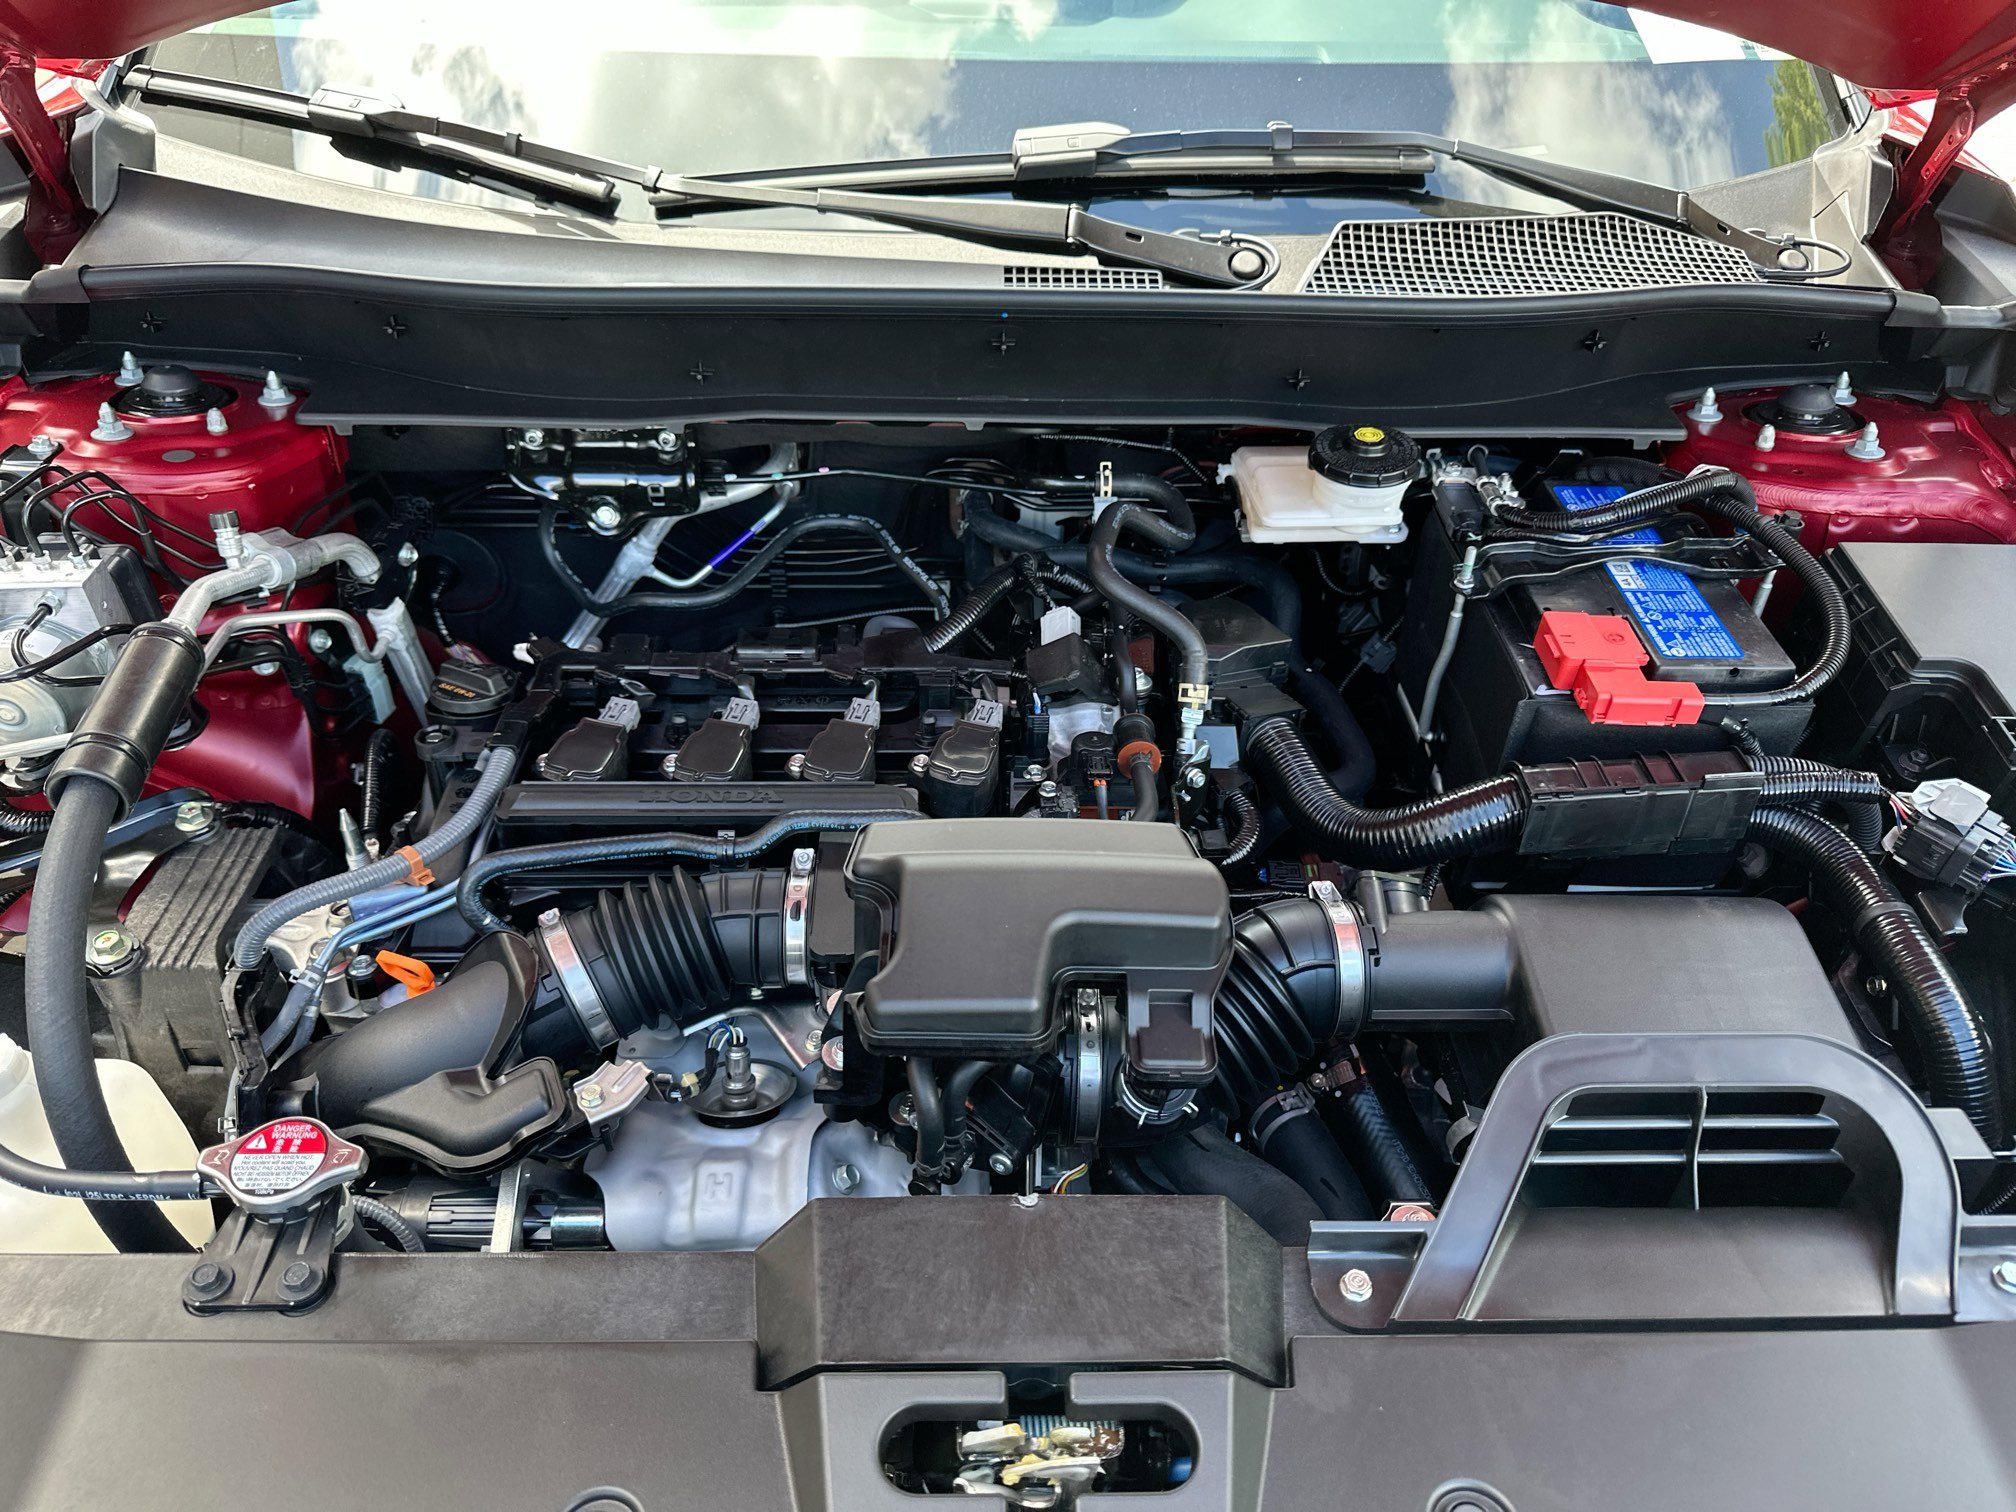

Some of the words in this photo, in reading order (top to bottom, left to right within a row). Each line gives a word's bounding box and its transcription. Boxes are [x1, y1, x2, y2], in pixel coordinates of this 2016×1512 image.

[638, 788, 784, 804] HONDA
[273, 1124, 312, 1133] DANGER
[271, 1131, 318, 1139] WARNUNG
